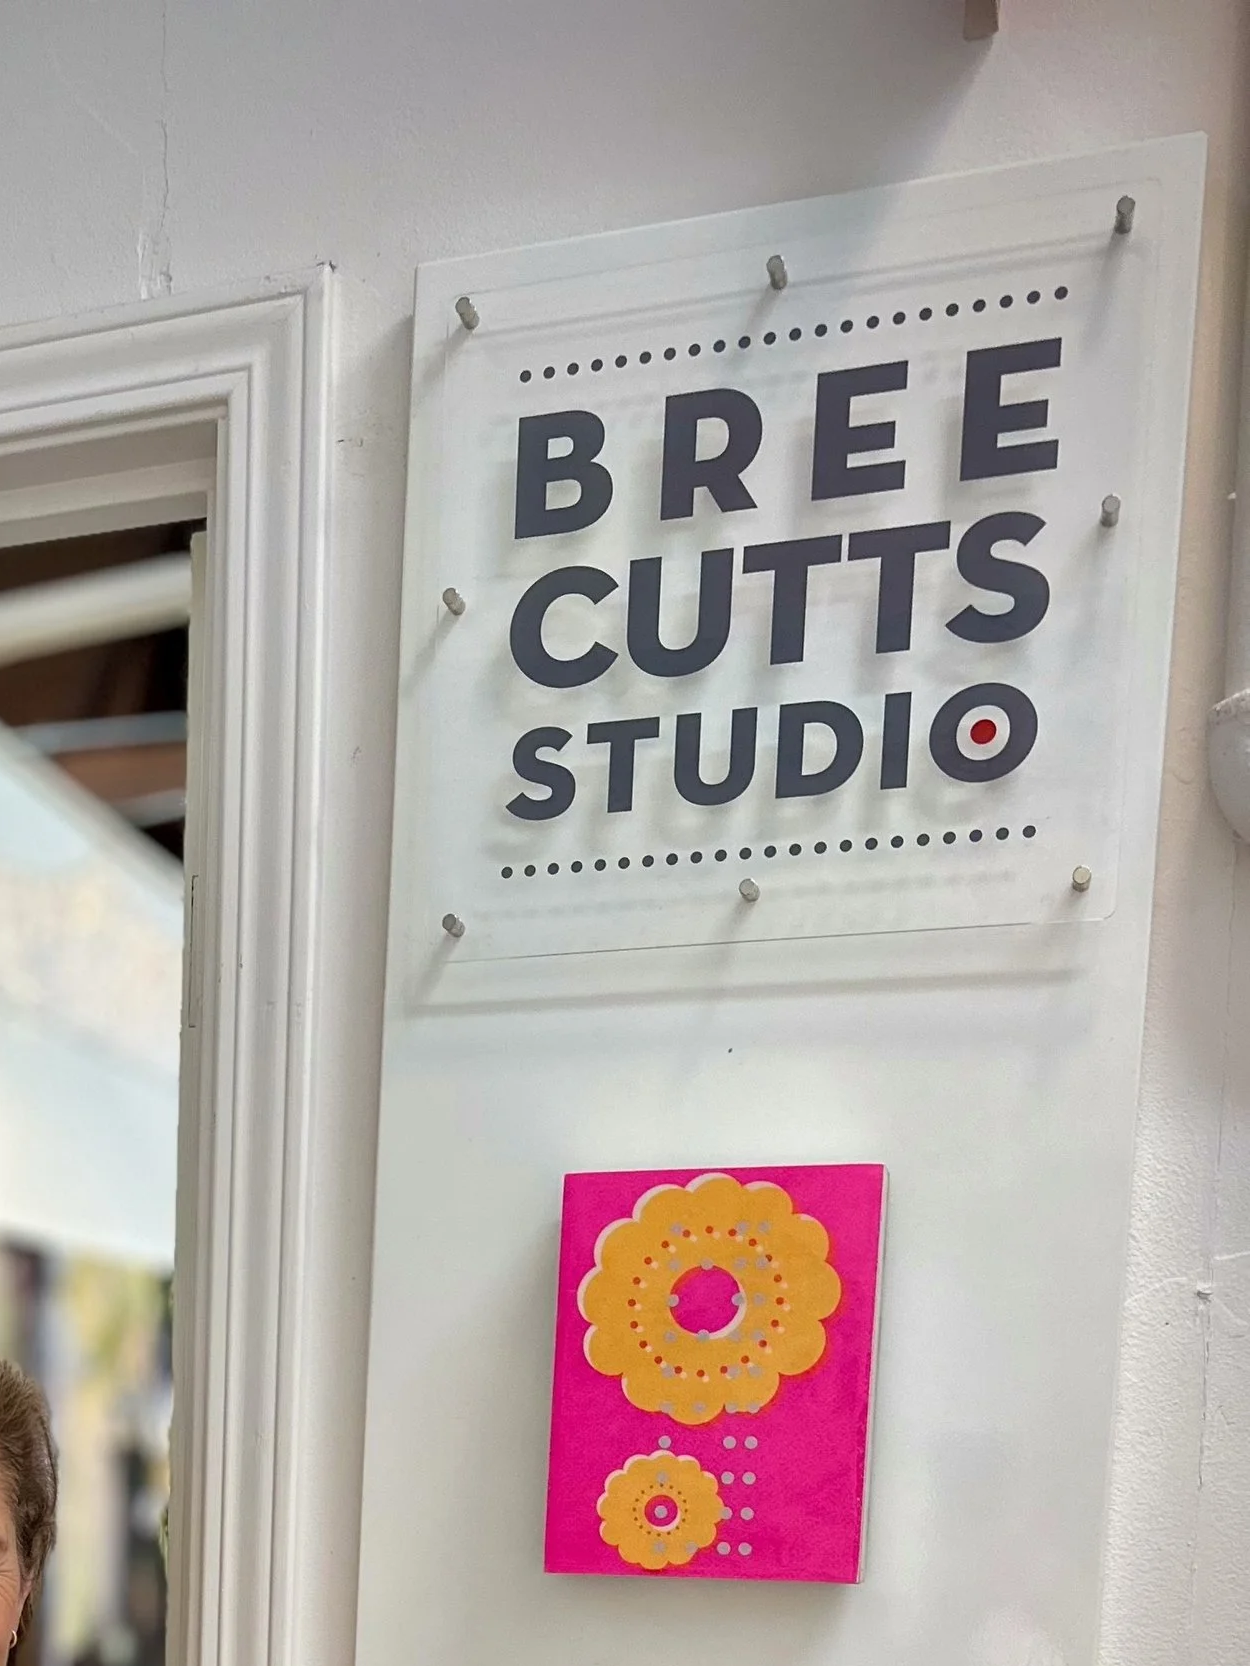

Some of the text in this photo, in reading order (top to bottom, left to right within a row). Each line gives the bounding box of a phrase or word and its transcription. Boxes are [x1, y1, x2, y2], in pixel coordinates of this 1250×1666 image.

[514, 337, 1063, 540] BREE
[509, 510, 1051, 689] CUTTS
[505, 682, 1038, 821] STUDIO
